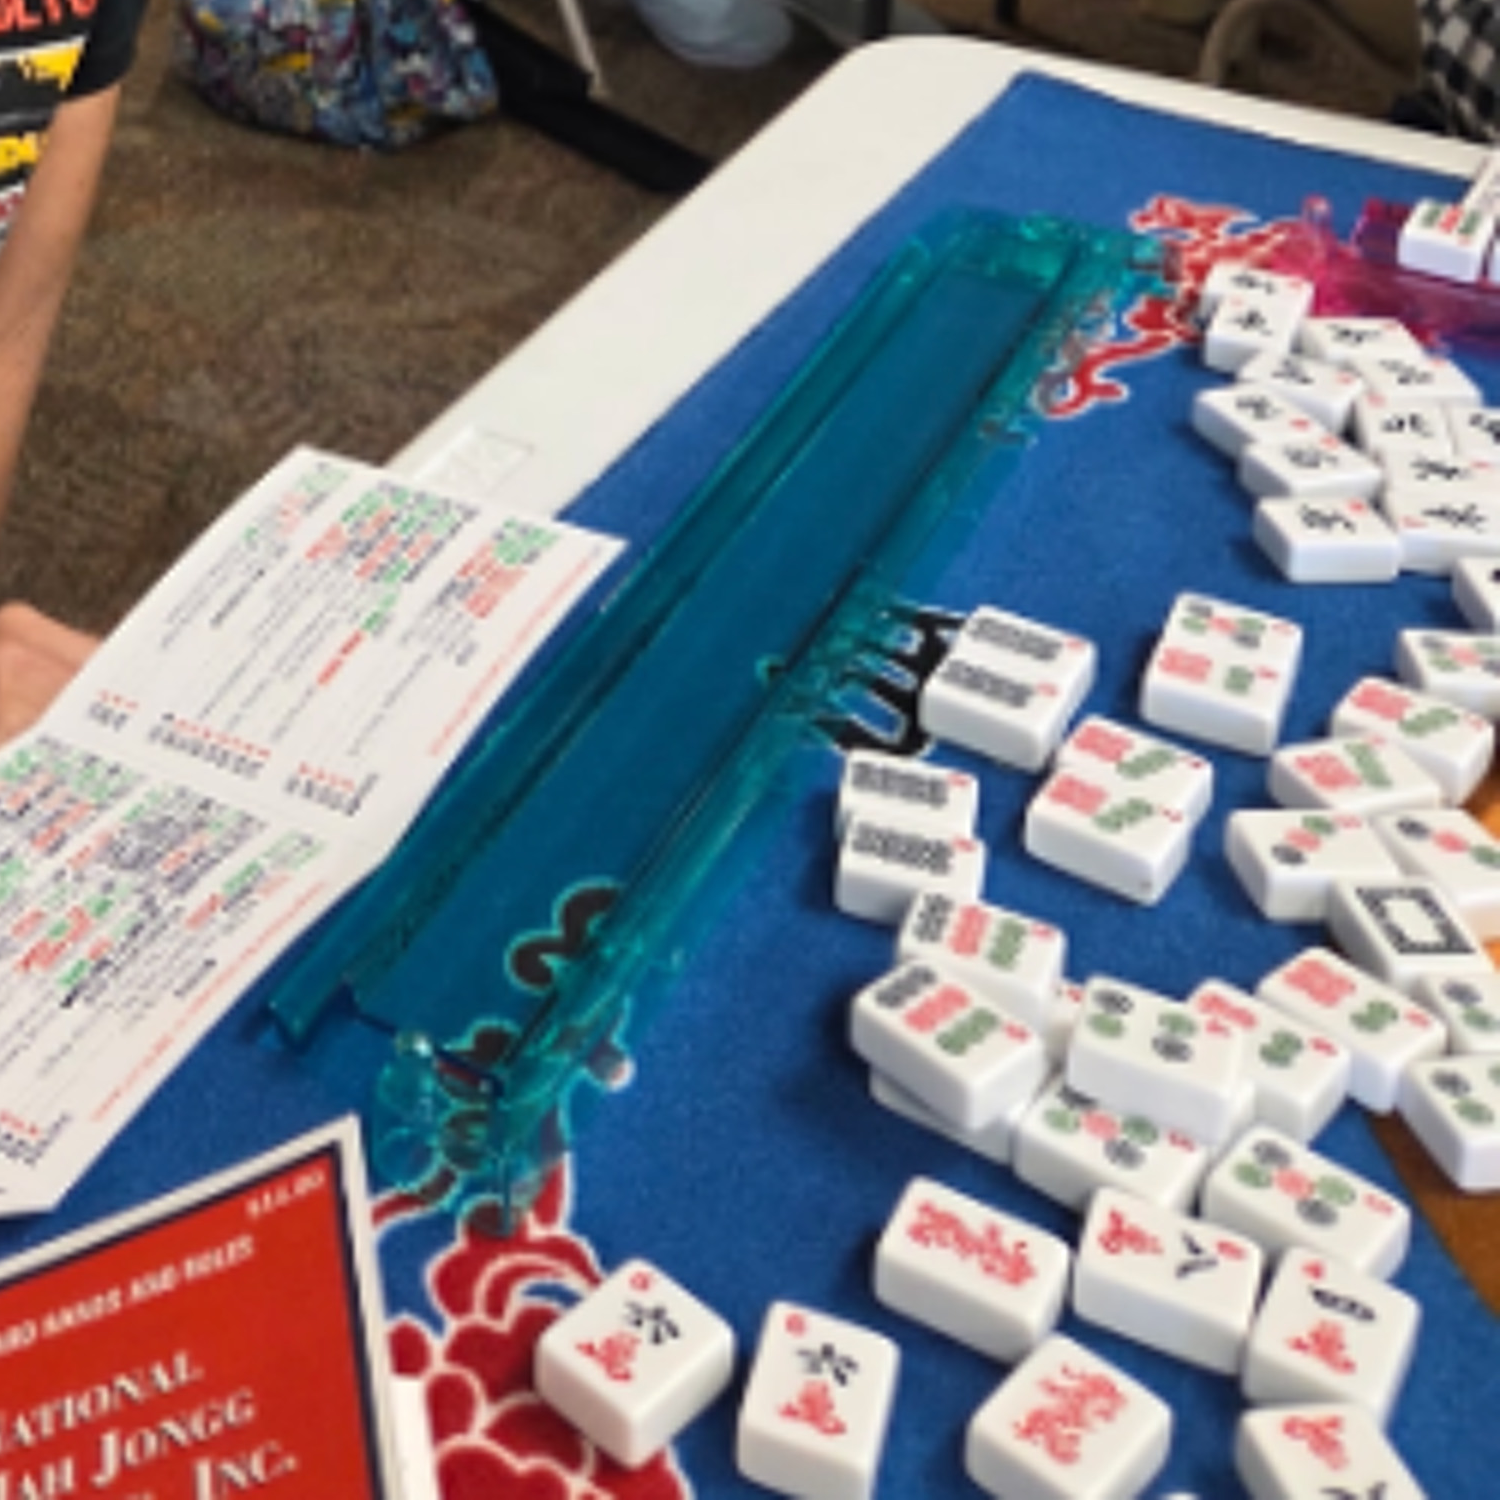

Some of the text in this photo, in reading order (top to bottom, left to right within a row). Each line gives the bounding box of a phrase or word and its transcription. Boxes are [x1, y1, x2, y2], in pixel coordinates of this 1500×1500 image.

[40, 1288, 122, 1338] HANDS
[129, 1264, 179, 1304] AND
[183, 1233, 256, 1283] RULES
[90, 1387, 257, 1489] JONGG
